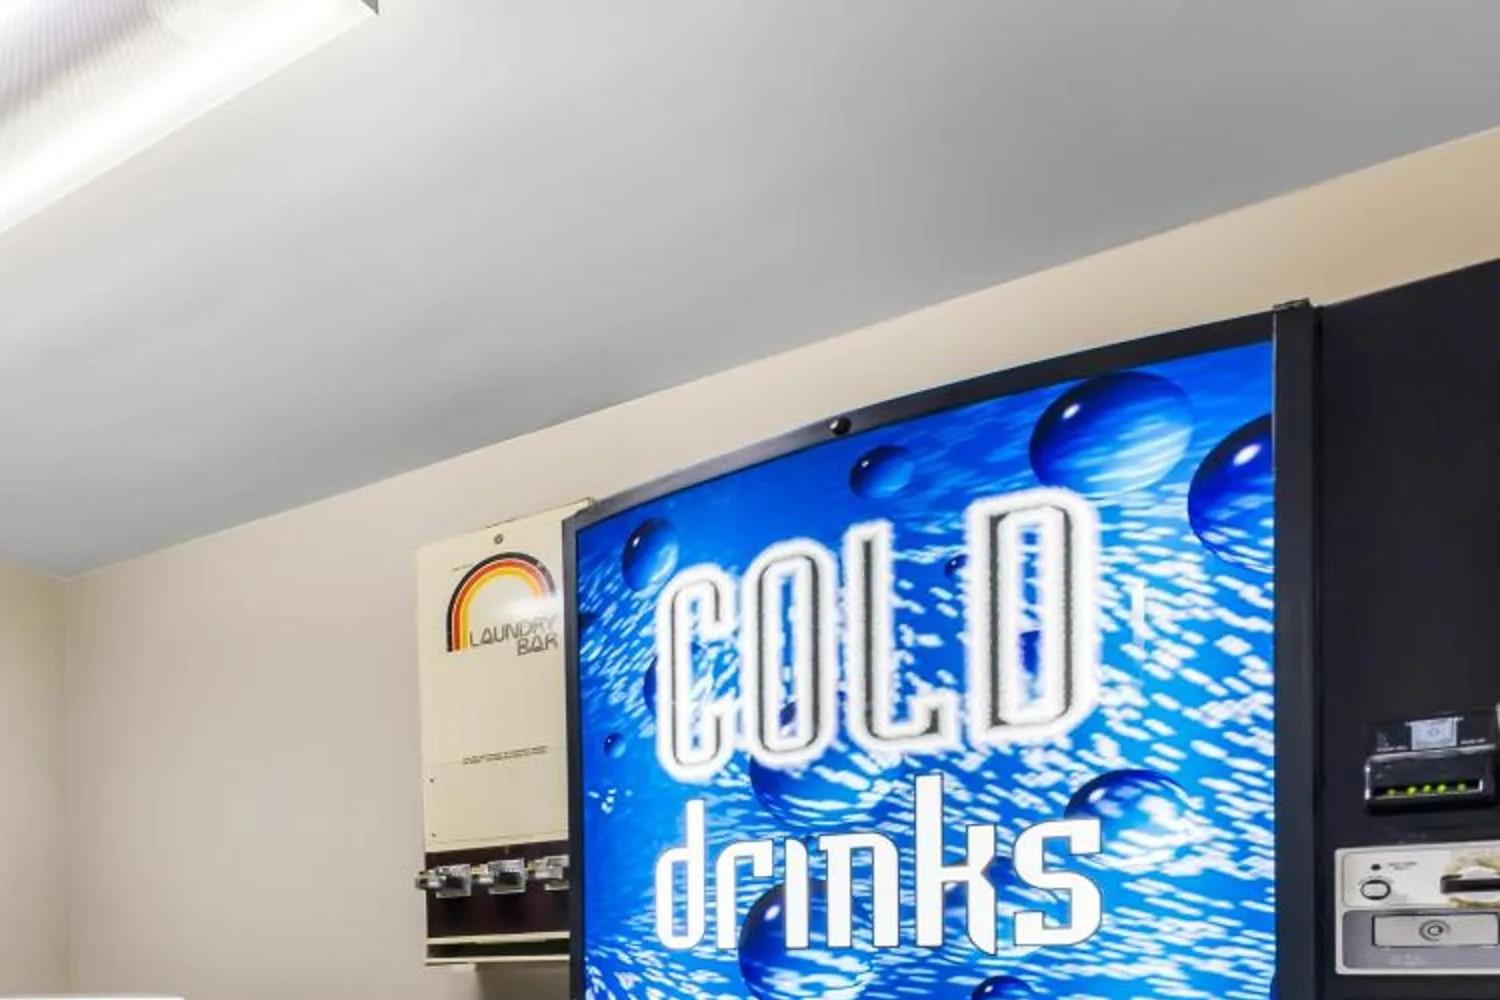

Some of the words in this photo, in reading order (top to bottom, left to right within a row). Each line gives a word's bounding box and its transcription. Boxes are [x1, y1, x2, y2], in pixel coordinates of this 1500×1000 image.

[469, 613, 559, 647] LAUNDRY
[517, 633, 558, 656] BAR
[656, 486, 1100, 782] COLD
[656, 773, 1101, 956] drinks
